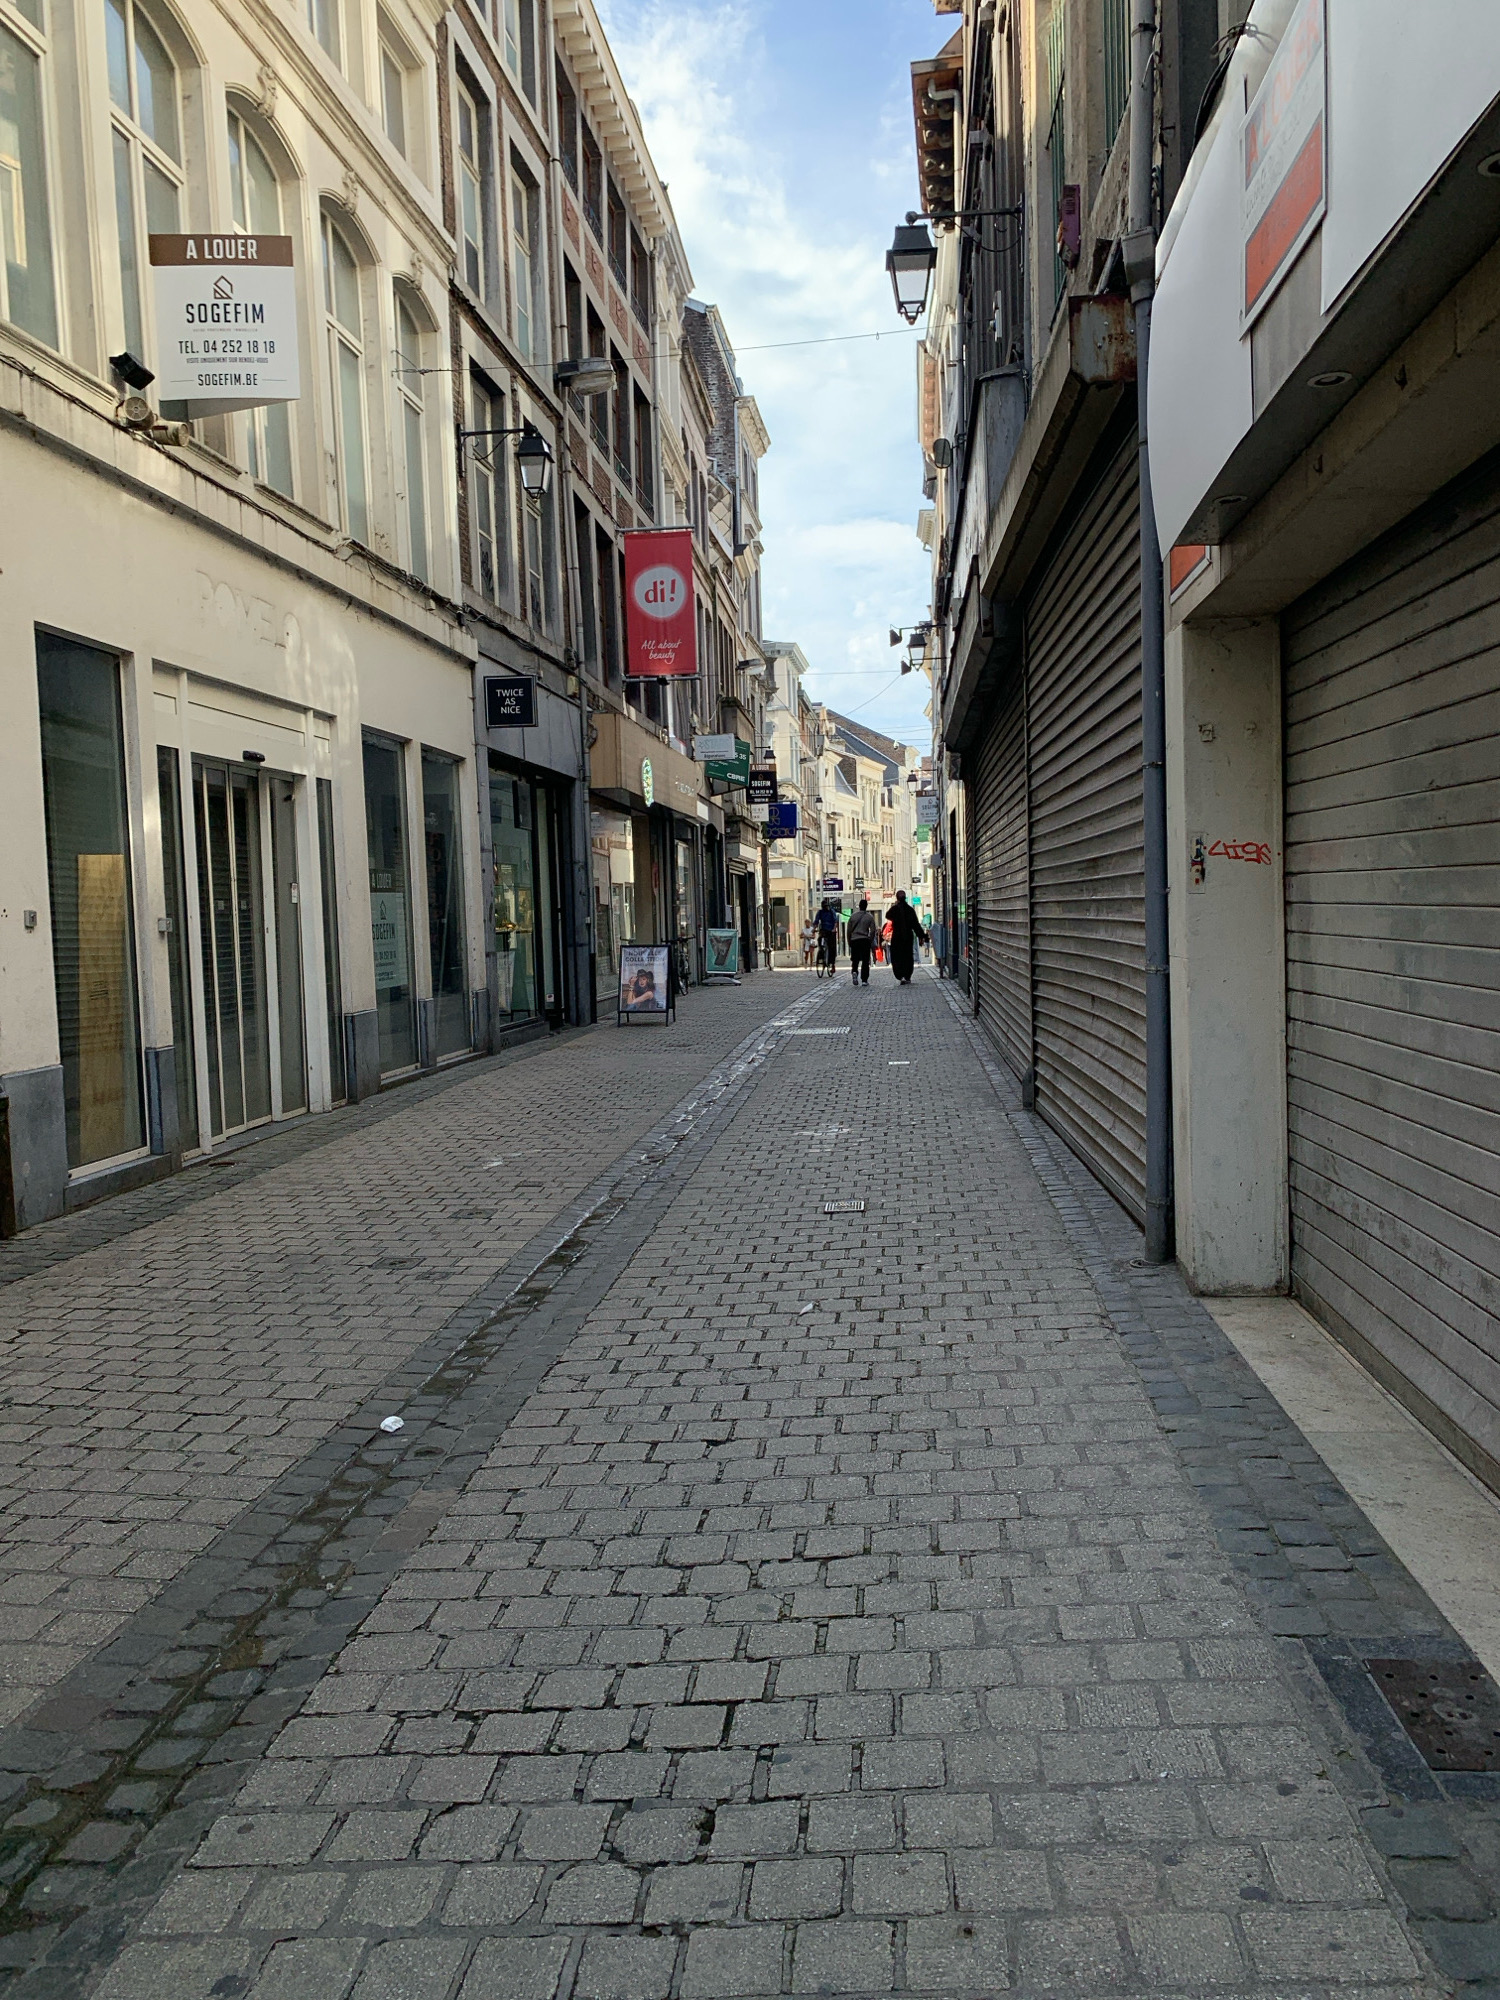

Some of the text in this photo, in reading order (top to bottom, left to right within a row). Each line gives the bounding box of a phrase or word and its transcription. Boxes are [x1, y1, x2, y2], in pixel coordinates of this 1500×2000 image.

[186, 238, 258, 260] A LOUER
[185, 303, 264, 324] SOGEFIM
[178, 339, 276, 354] TEL. 04 252 18 18
[197, 373, 258, 386] SOGEFIM.BE
[644, 578, 676, 604] di!
[641, 638, 682, 650] All about
[648, 649, 676, 665] beauty
[495, 688, 525, 697] TWICE
[504, 697, 516, 706] AS
[500, 705, 521, 714] NICE
[726, 773, 746, 783] CBRE
